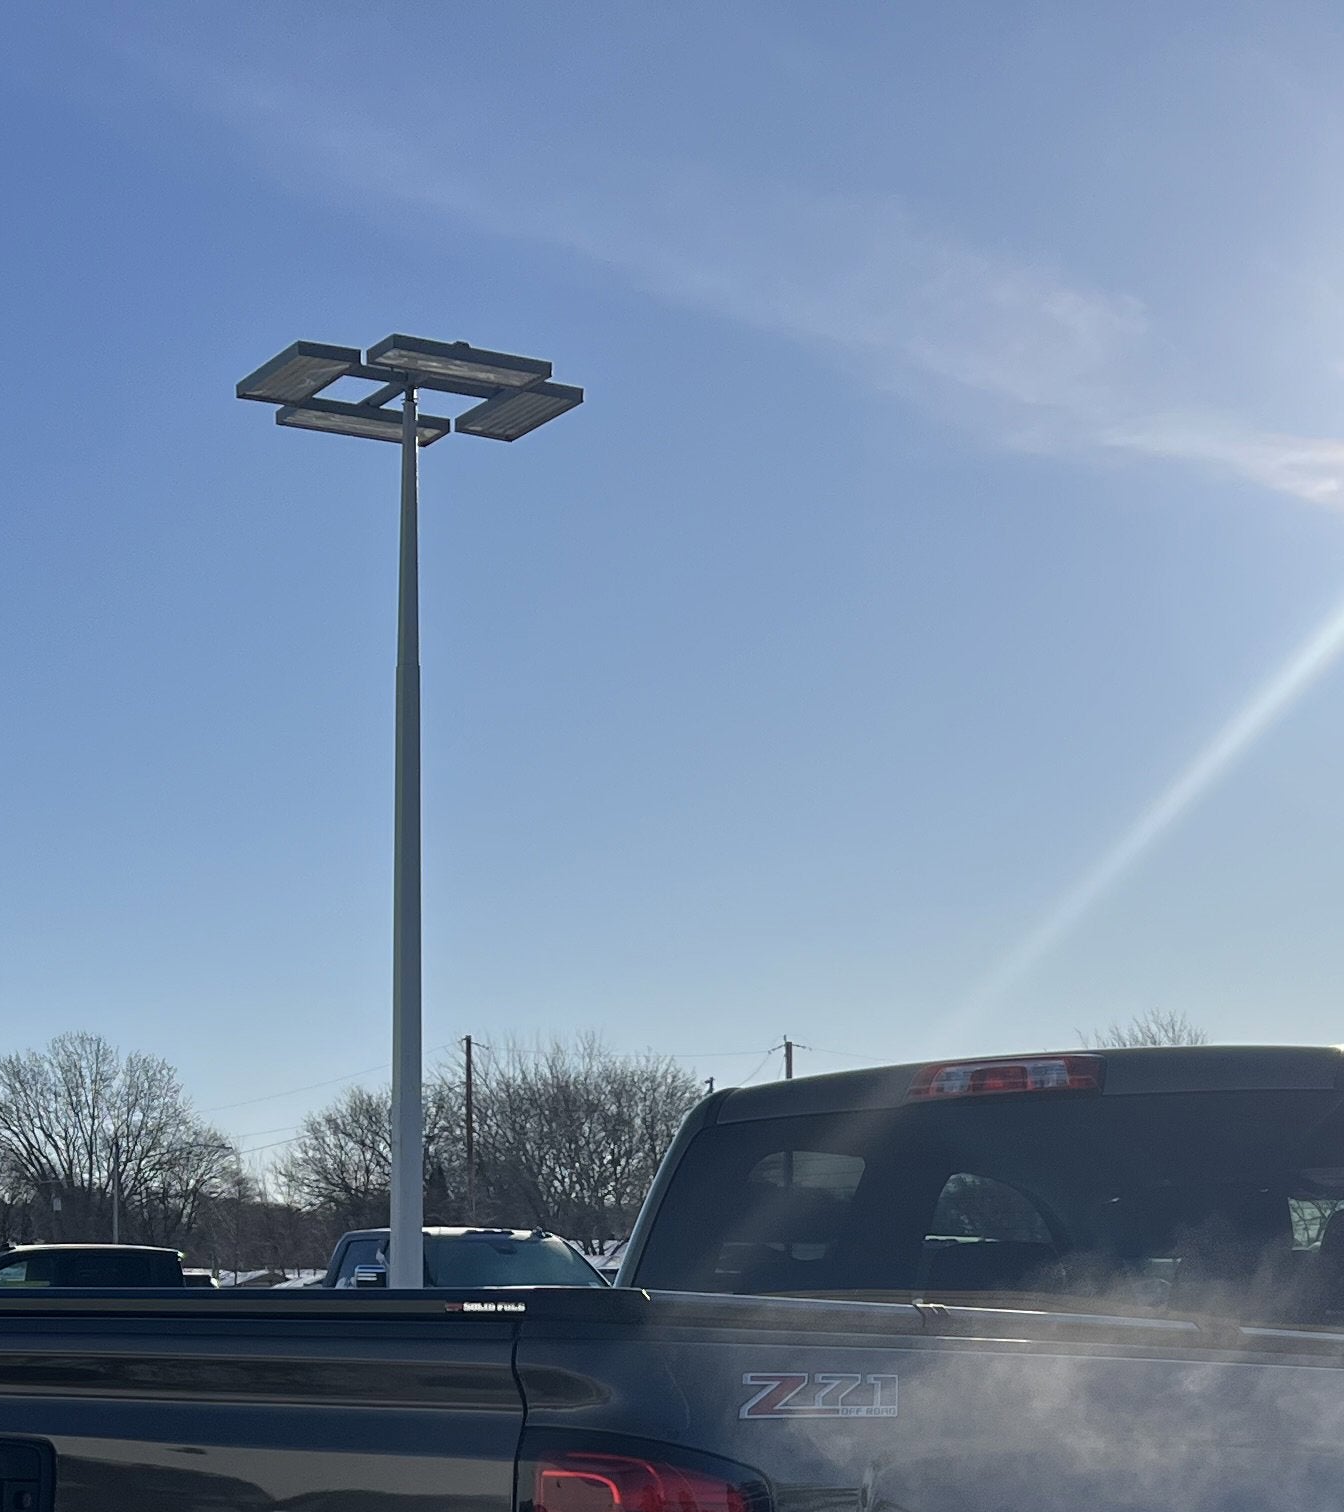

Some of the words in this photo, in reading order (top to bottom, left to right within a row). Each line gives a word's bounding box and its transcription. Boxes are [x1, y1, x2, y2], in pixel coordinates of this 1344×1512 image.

[739, 1372, 898, 1419] Z71
[841, 1407, 862, 1416] OFF
[865, 1407, 897, 1416] ROAD
